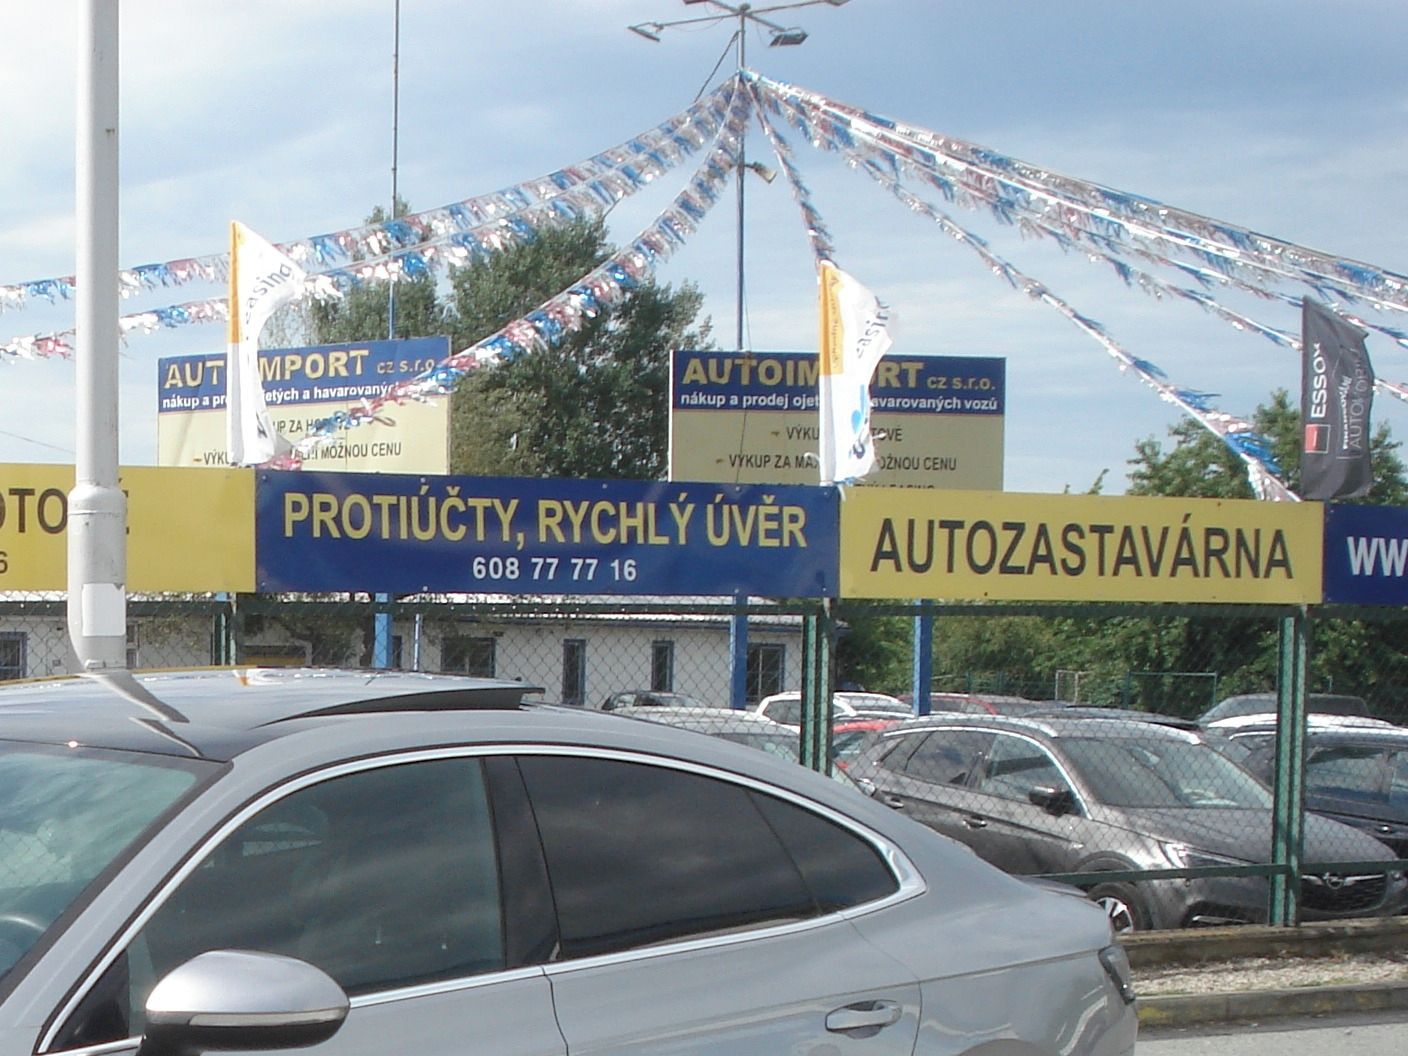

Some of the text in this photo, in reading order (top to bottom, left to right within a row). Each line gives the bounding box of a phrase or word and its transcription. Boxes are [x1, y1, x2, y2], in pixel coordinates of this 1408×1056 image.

[163, 349, 370, 389] AUTMPORT
[377, 361, 394, 374] cz
[682, 358, 996, 390] AUTOIMRT cz s.r.o.
[162, 396, 199, 410] nákup
[202, 397, 209, 406] a
[302, 389, 310, 399] a
[680, 392, 997, 411] nákup a prodej ojet avarovaných vozů
[786, 425, 819, 441] VÝKU
[321, 442, 368, 460] MOŽNOU
[371, 442, 401, 457] CENU
[729, 452, 771, 468] VÝKUP
[774, 455, 790, 469] ZA
[877, 453, 920, 470] OŽNOU
[923, 456, 957, 471] CENU
[284, 486, 808, 550] PROTIÚČTY, RYCHLÝ ÚVĚR
[869, 513, 1294, 580] AUTOZASTAVÁRNA
[472, 558, 636, 583] 608 77 77 16
